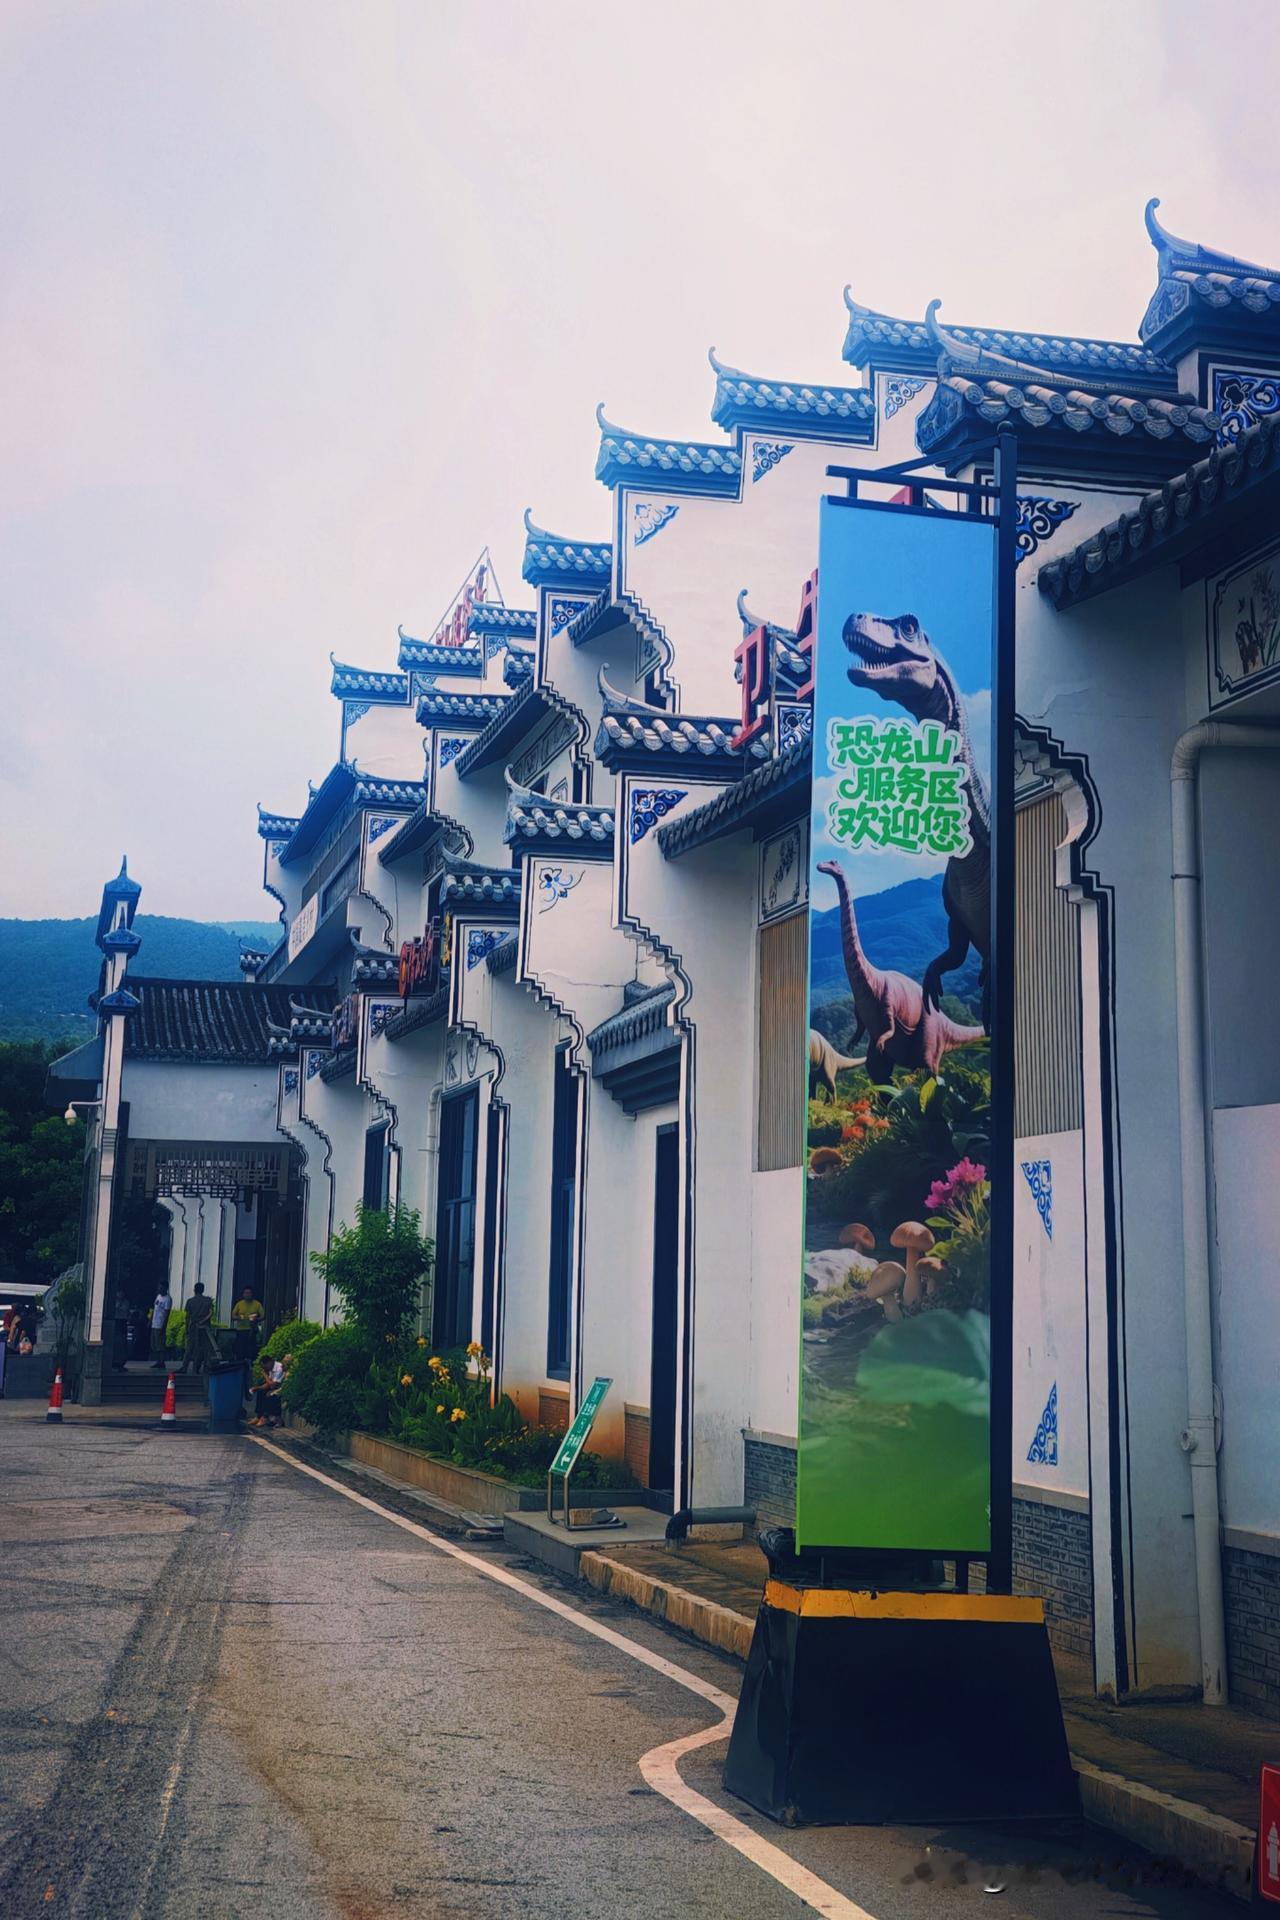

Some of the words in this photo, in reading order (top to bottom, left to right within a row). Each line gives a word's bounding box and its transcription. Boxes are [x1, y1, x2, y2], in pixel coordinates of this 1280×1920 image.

[836, 724, 952, 766] 恐龙山
[838, 764, 960, 807] 服务区
[837, 801, 964, 853] 欢迎您
